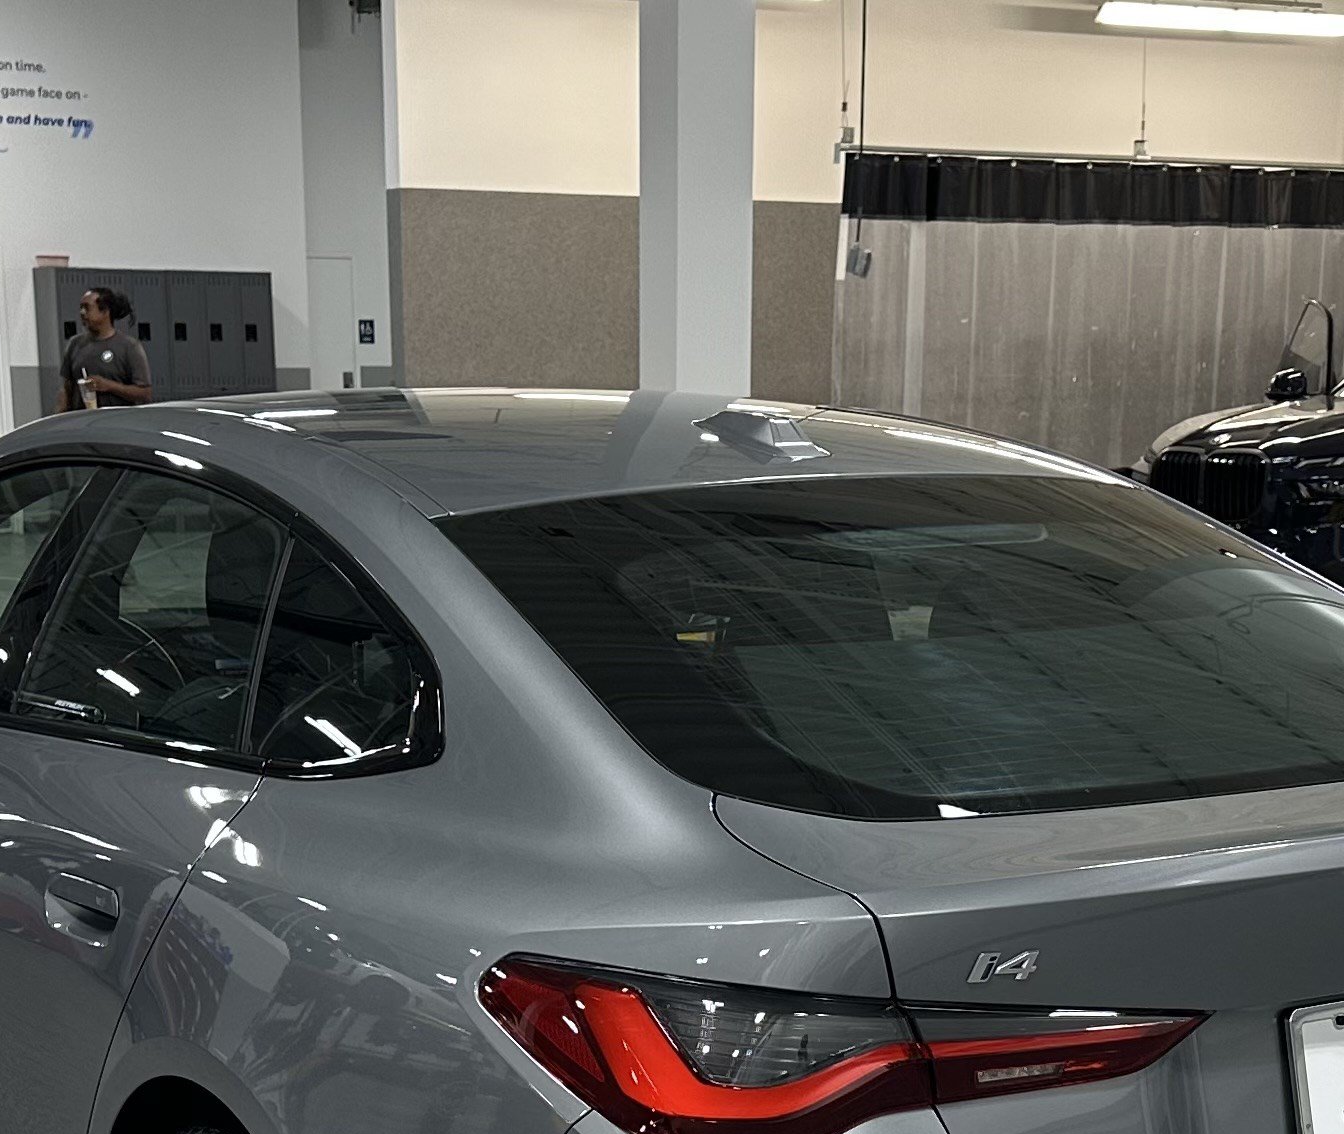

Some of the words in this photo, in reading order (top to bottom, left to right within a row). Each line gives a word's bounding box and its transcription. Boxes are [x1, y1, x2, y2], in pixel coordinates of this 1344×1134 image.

[0, 87, 35, 99] game
[38, 86, 63, 100] face
[65, 90, 81, 100] on
[6, 114, 31, 125] and
[34, 114, 65, 126] have
[966, 949, 1040, 984] i4
